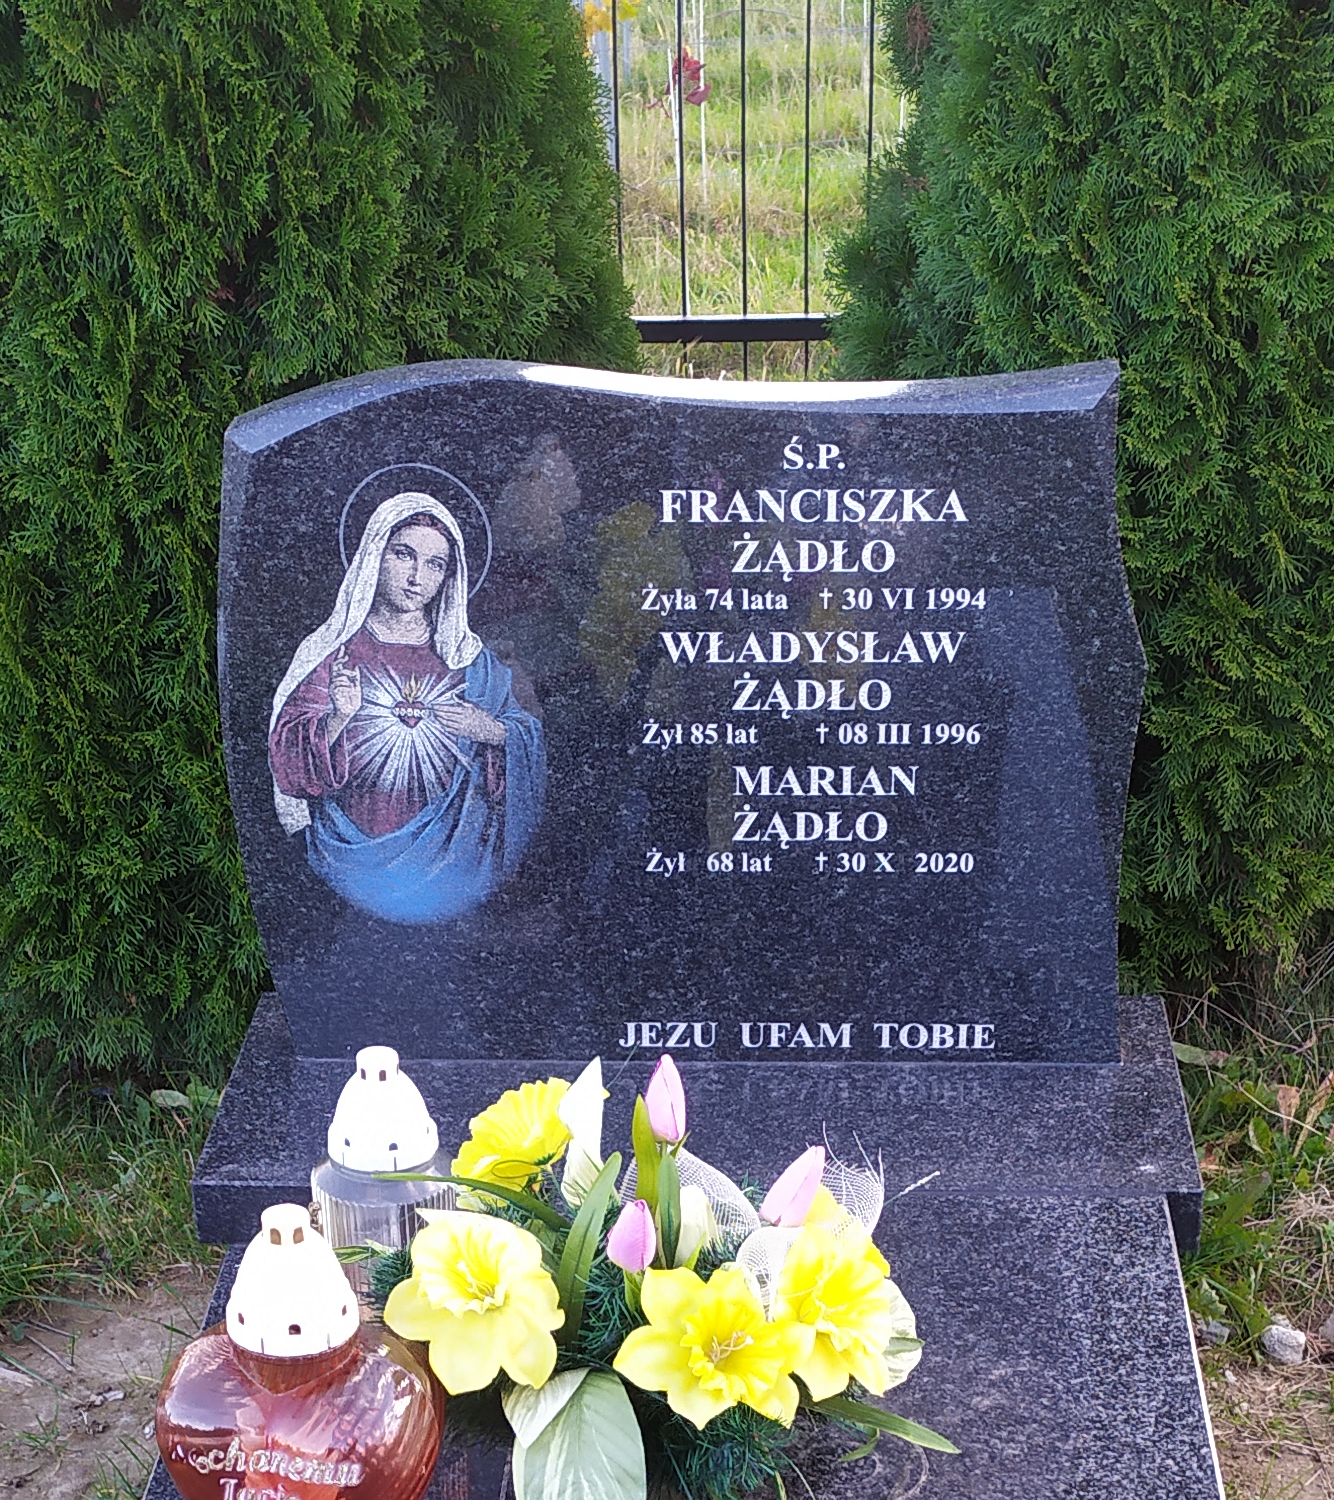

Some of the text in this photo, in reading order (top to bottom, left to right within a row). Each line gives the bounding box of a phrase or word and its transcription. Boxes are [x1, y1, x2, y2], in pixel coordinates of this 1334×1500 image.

[782, 435, 847, 471] Ś.P.
[659, 488, 969, 523] FRANCISZKA
[731, 531, 896, 583] ŻĄDŁO
[640, 582, 988, 617] Żyła 74 lata 30 VI 1994
[659, 630, 967, 664] WŁADYSŁAW
[731, 671, 893, 720] ŻĄDŁO
[641, 718, 982, 746] Żył 85 lat 08 III 1996
[732, 765, 920, 797] MARIAN
[731, 803, 889, 850] ŻĄDŁO
[644, 847, 975, 877] Żył 68 lat 30 X 2020
[618, 1022, 996, 1050] JEZU UFAM TOBIE
